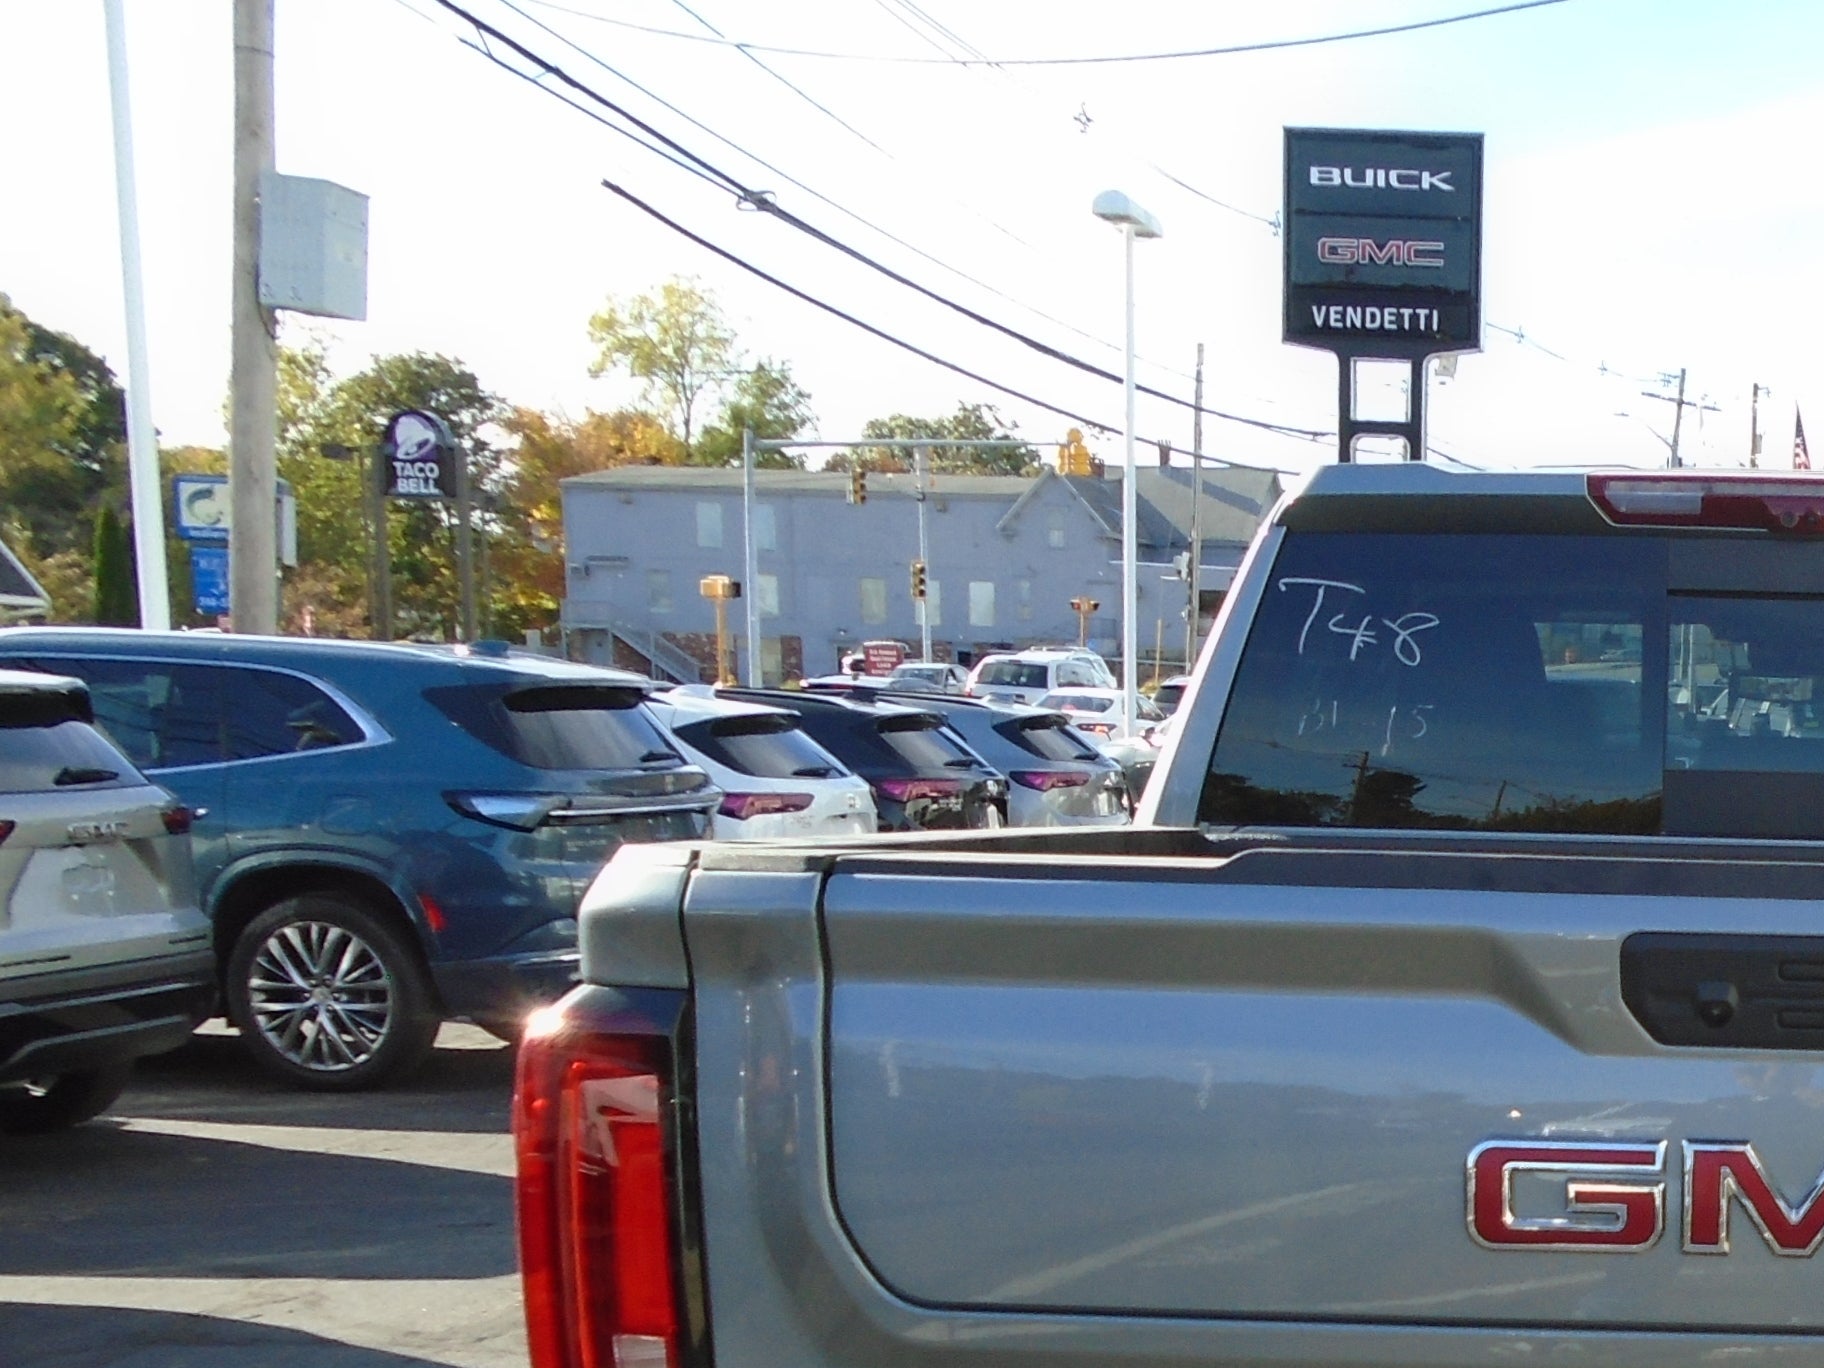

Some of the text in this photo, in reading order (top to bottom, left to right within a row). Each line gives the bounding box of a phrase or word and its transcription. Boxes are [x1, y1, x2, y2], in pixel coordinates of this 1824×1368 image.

[1309, 166, 1455, 191] BUICK
[1317, 236, 1444, 267] GMC
[1311, 304, 1440, 332] VENDETTI
[392, 461, 440, 479] TACO
[397, 478, 441, 494] BELL
